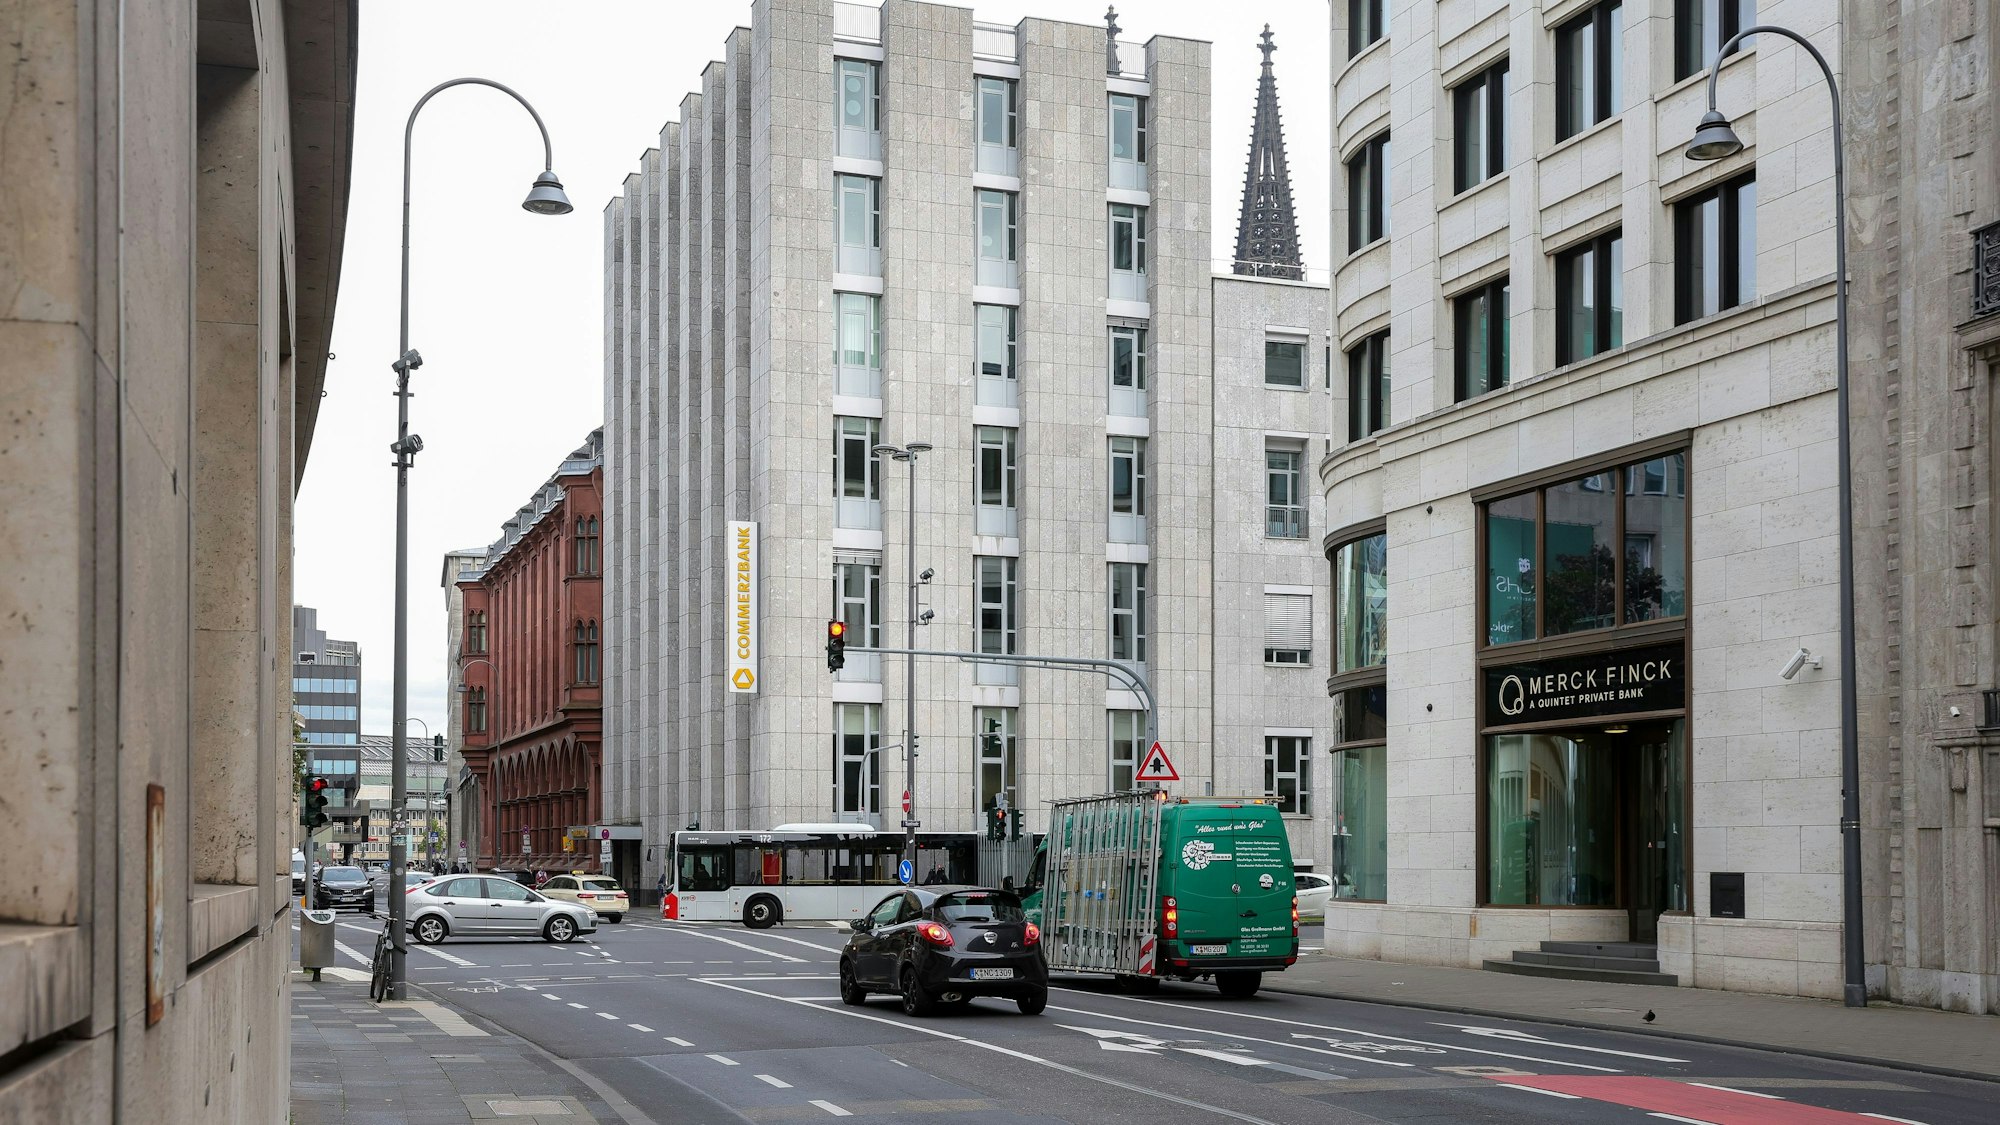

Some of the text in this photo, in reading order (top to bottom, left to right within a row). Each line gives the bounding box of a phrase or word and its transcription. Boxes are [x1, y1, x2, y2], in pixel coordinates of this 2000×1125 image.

[737, 526, 751, 660] COMMERZBANK
[1529, 659, 1672, 695] MERCK FINCK
[1529, 687, 1644, 709] A QUINTET PRIVATE BANK
[1216, 823, 1232, 832] rund
[759, 834, 772, 843] 172
[1212, 945, 1224, 953] 207
[984, 969, 994, 977] NC
[994, 969, 1012, 977] 1309
